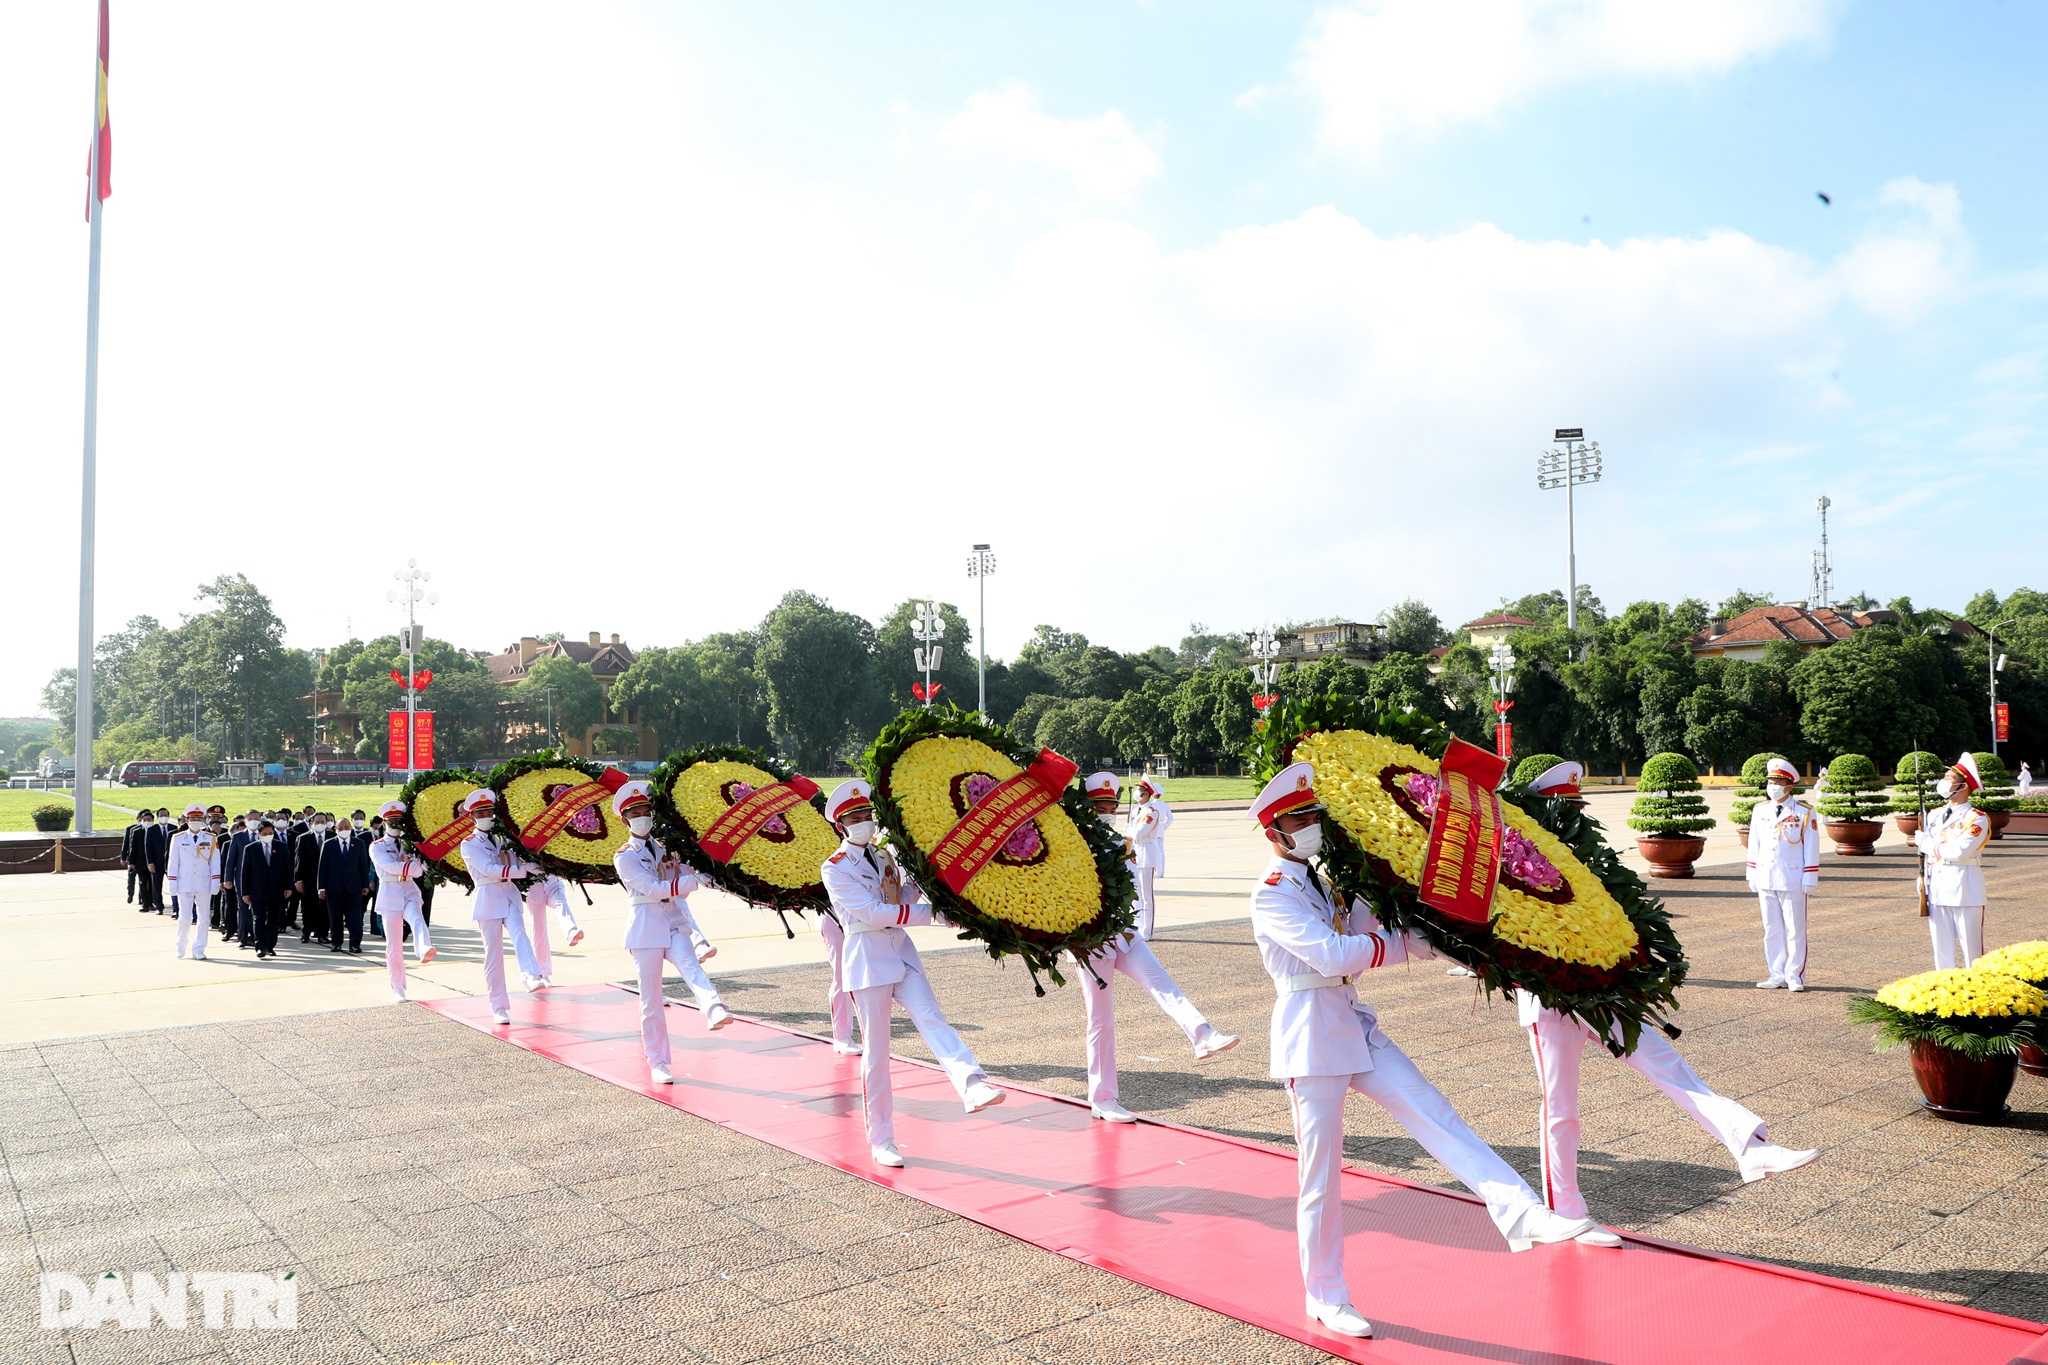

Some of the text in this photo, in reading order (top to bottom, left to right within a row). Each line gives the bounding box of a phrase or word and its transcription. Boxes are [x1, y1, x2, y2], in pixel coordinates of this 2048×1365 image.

[1437, 807, 1470, 831] CHỦ
[941, 840, 963, 858] ĐỜI
[952, 827, 976, 848] NHỚ
[974, 807, 996, 826] CHỦ
[1441, 826, 1467, 845] ƠN
[1434, 839, 1465, 864] NHỚ
[1430, 859, 1461, 880] ĐỜI
[1427, 875, 1460, 898] ĐỜI
[1469, 879, 1486, 899] BAN
